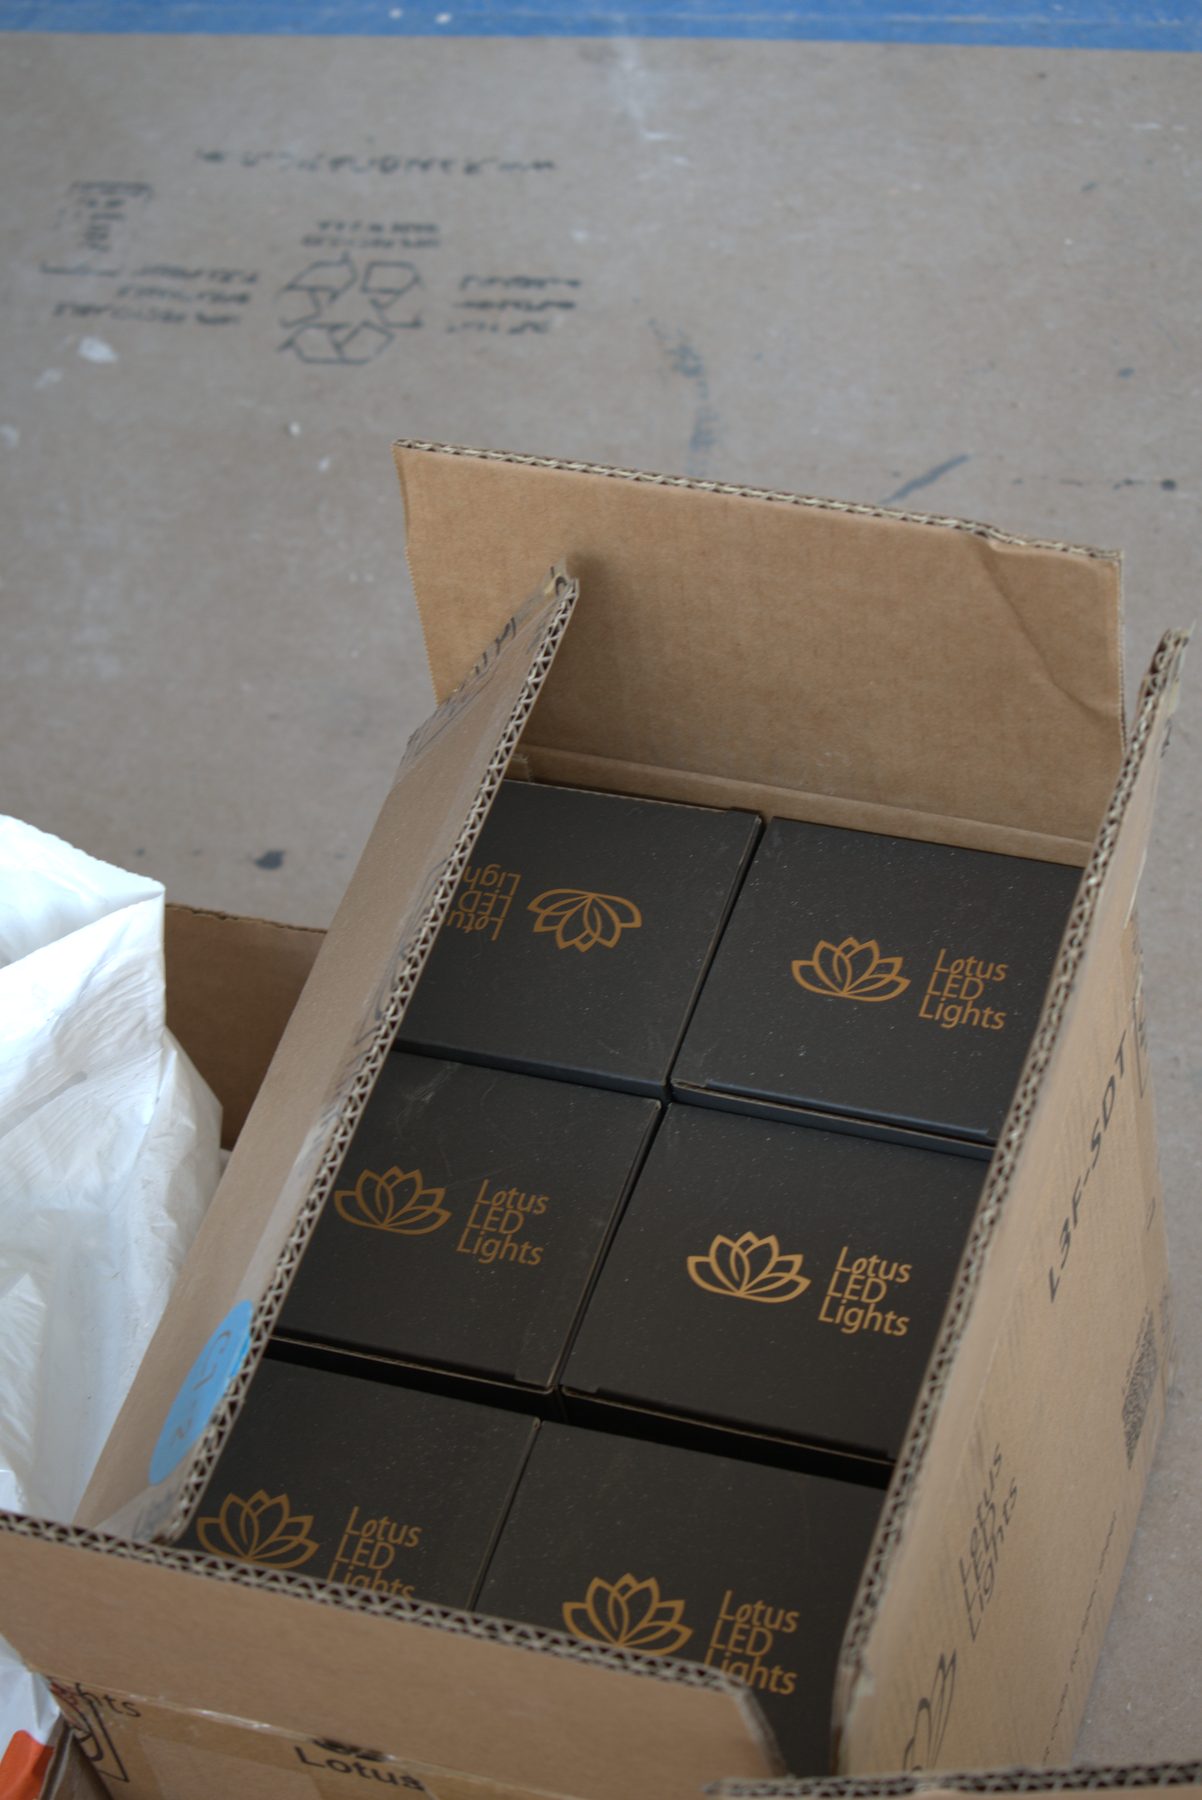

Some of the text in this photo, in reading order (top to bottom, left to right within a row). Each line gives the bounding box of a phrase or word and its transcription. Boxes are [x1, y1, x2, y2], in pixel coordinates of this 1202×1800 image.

[462, 863, 522, 897] Ligh
[459, 890, 512, 919] LED
[447, 910, 504, 941] Lotu
[934, 948, 1009, 982] Lotus
[926, 971, 985, 1001] LED
[918, 994, 1008, 1030] Lights
[475, 1178, 550, 1216] Lotus
[466, 1203, 525, 1235] LED
[455, 1228, 545, 1266] Lights
[835, 1246, 913, 1284] Lotus
[826, 1270, 888, 1304] LED
[817, 1296, 911, 1336] Lights
[344, 1505, 422, 1548] Lotus
[959, 1442, 1002, 1585] Lotus
[334, 1533, 396, 1570] LED
[968, 1477, 1018, 1643] Lights
[718, 1589, 800, 1633] Lotus
[709, 1618, 774, 1657] LED
